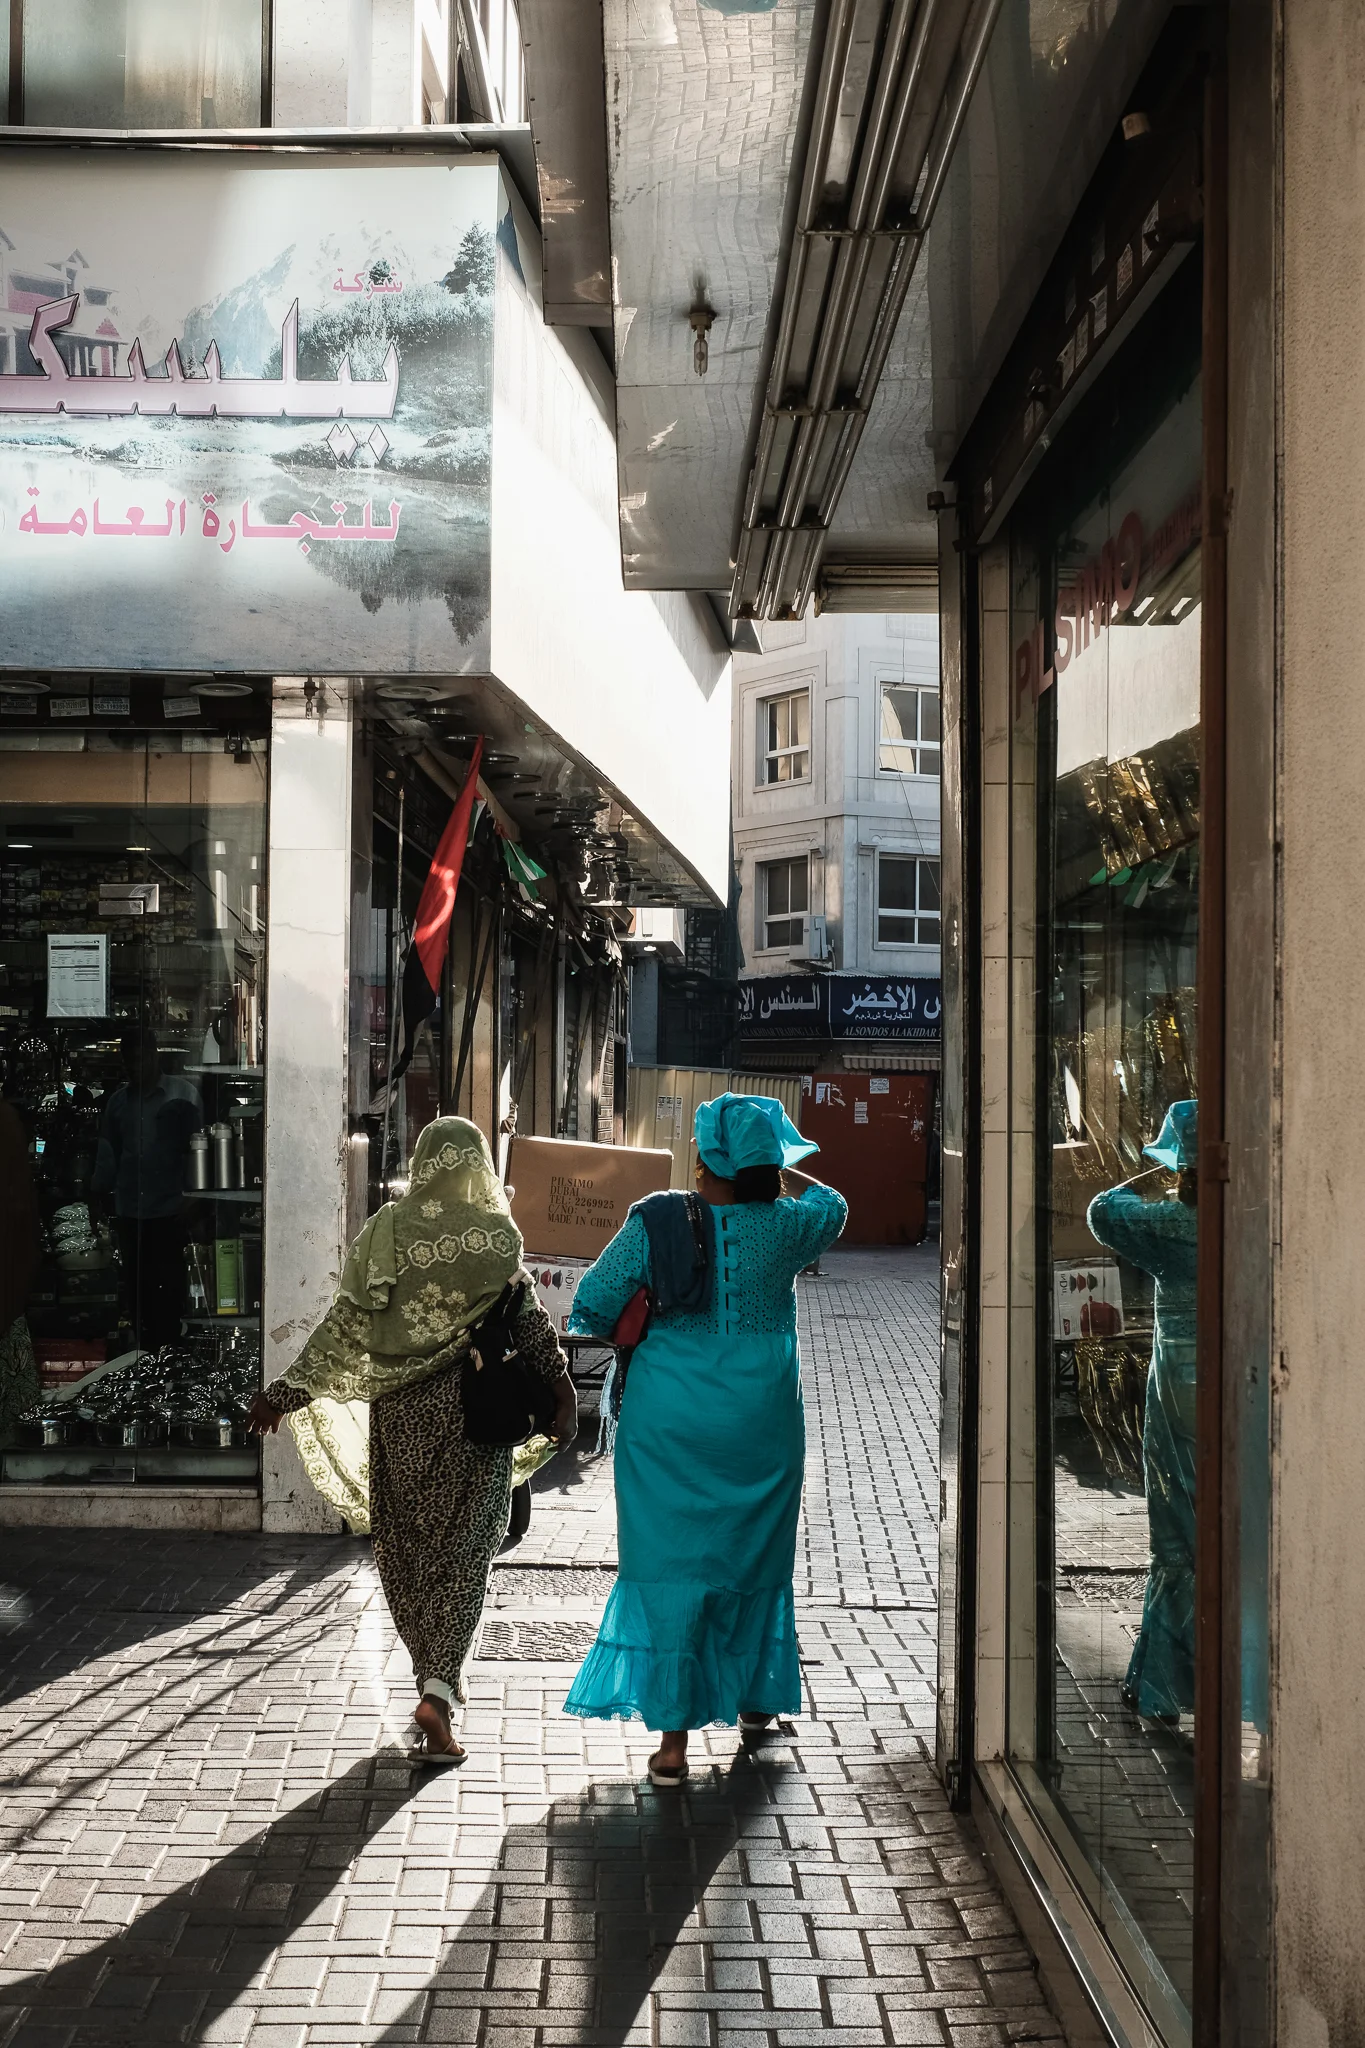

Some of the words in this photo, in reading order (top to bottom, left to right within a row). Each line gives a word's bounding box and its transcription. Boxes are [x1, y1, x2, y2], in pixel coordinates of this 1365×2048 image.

[333, 266, 403, 300] شركة
[18, 485, 188, 538] العامة
[203, 490, 402, 554] للتجارة
[760, 982, 820, 1018] السندس
[842, 983, 916, 1015] الاخضر
[882, 1010, 913, 1021] التجارية
[843, 1026, 889, 1037] ALSONDOS
[889, 1027, 937, 1038] ALAKHDAR
[551, 1176, 594, 1189] PILSIMO
[550, 1185, 580, 1197] DUBAI
[548, 1203, 578, 1215] C/NO:
[549, 1194, 572, 1205] TEL:
[575, 1197, 615, 1210] 2269925
[547, 1212, 572, 1225] MADE
[575, 1215, 587, 1226] IN
[590, 1217, 620, 1229] CHINA
